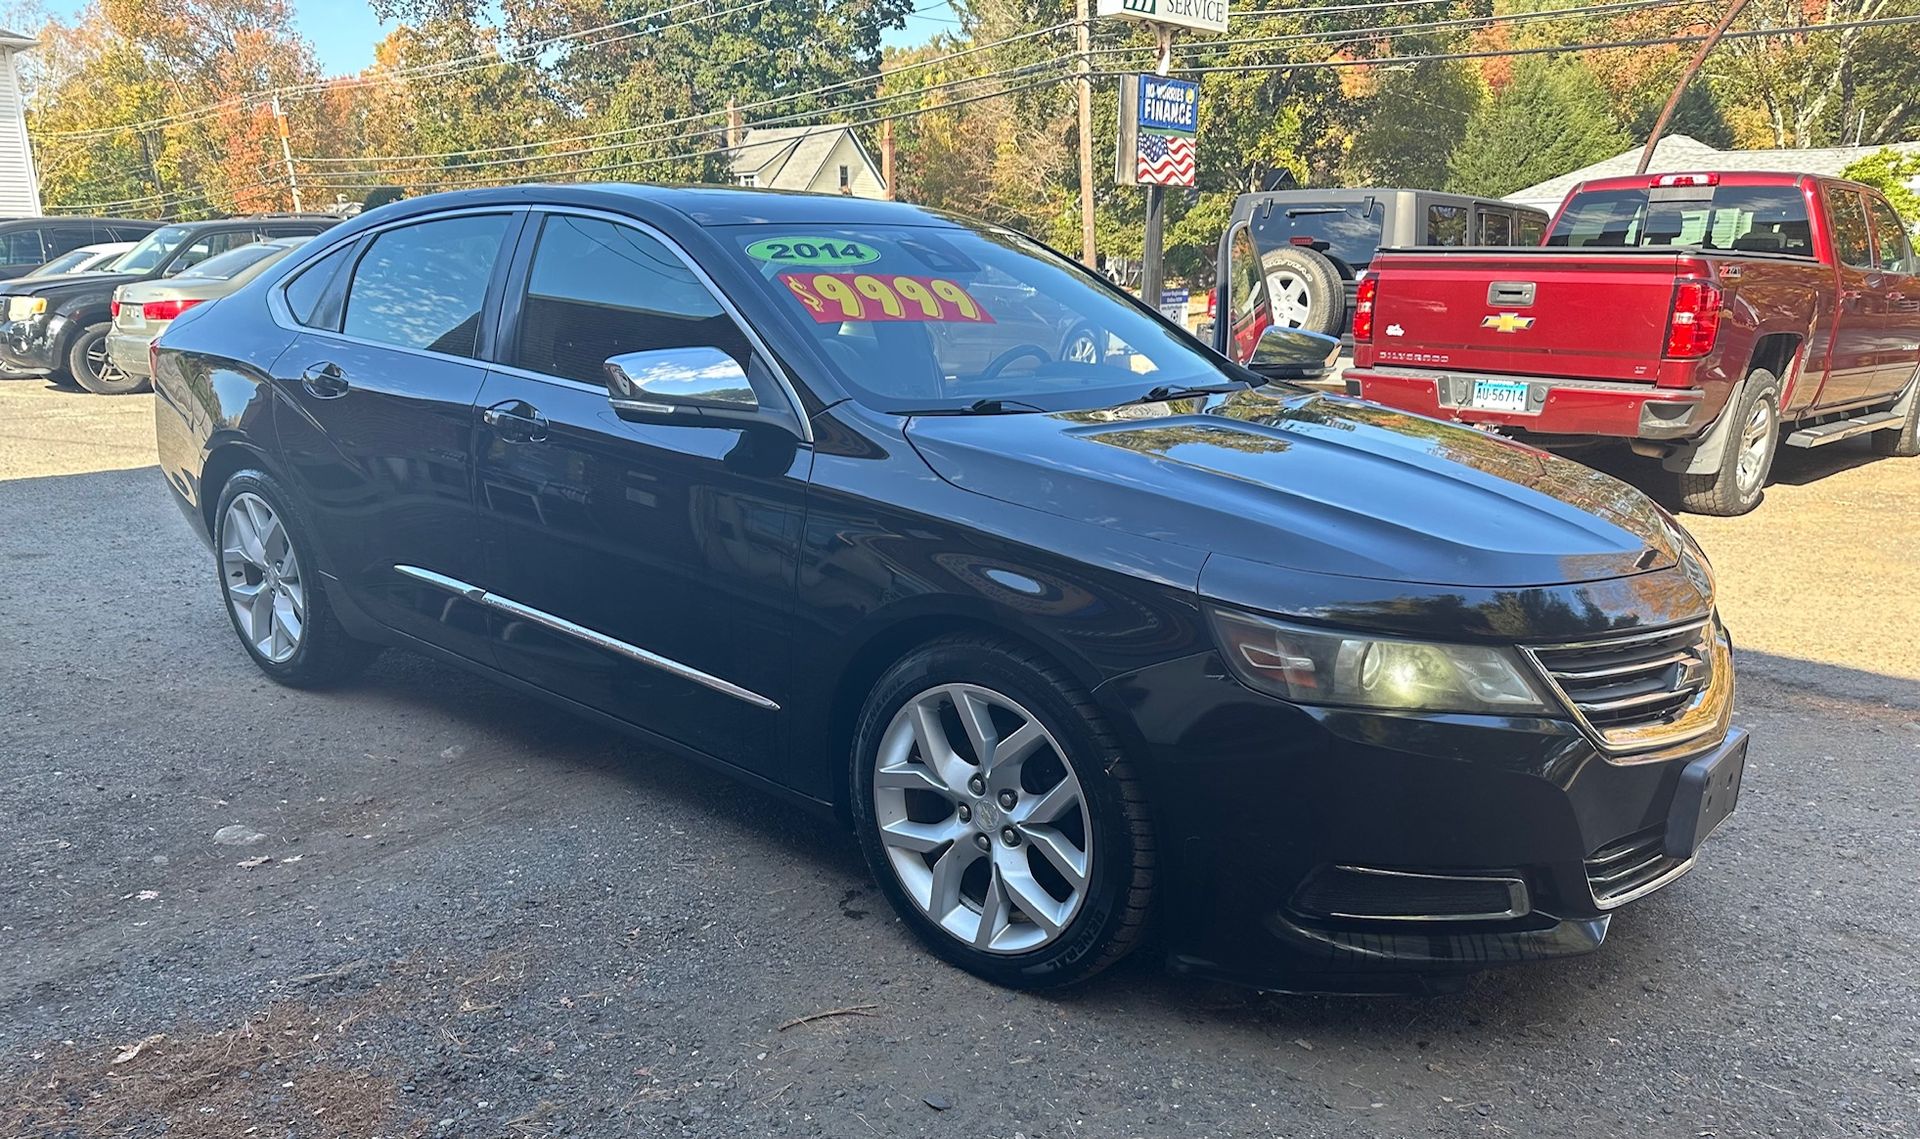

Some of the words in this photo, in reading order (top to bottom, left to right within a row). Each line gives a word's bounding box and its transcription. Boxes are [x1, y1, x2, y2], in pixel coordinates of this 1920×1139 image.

[1166, 0, 1224, 23] SERVICE
[1145, 83, 1155, 98] NO
[1144, 98, 1192, 125] FINANCE
[765, 243, 865, 260] 2014
[1719, 265, 1741, 277] Z71
[787, 274, 981, 321] $9999
[1379, 351, 1449, 363] SILVERADO
[1046, 908, 1107, 969] GENERAL
